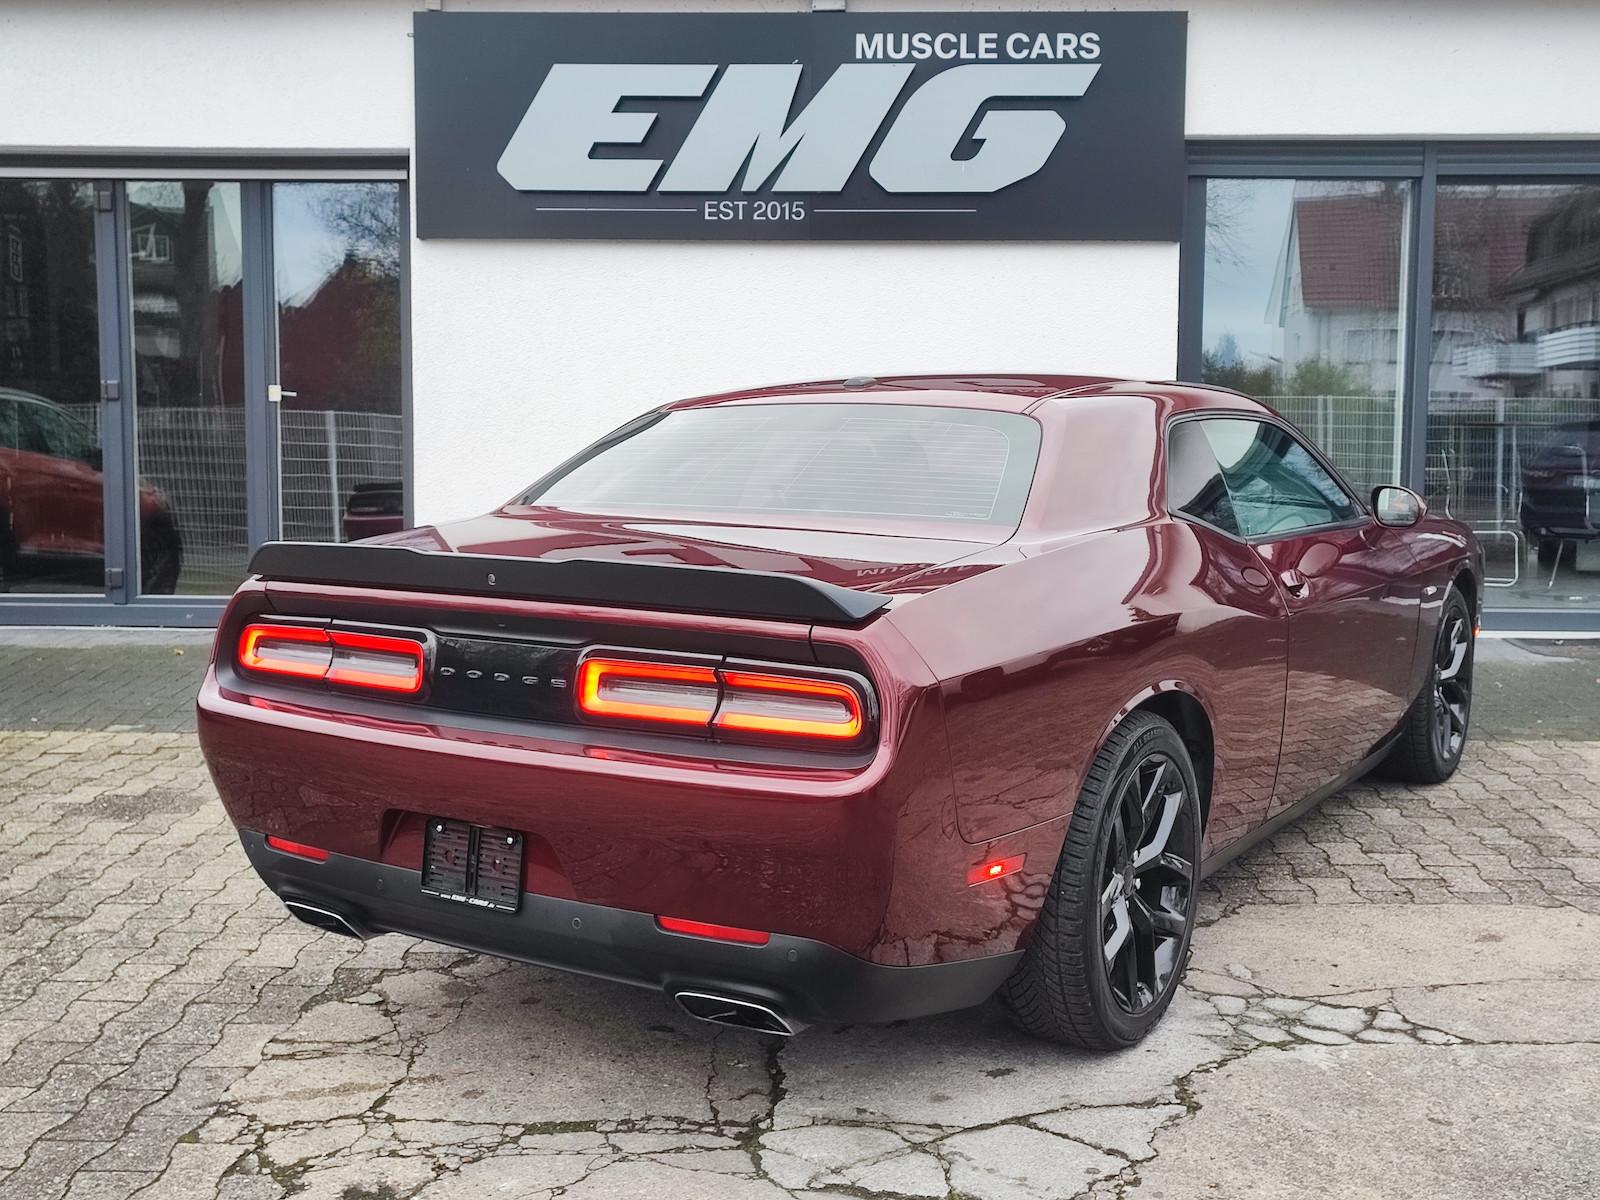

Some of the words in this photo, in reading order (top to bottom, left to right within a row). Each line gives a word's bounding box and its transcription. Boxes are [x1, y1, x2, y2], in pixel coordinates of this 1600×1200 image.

[855, 32, 998, 60] MUSCLE
[1005, 32, 1101, 60] CARS
[496, 63, 1102, 193] EMG
[704, 200, 748, 220] EST
[752, 200, 806, 221] 2015
[439, 666, 567, 688] DODGE
